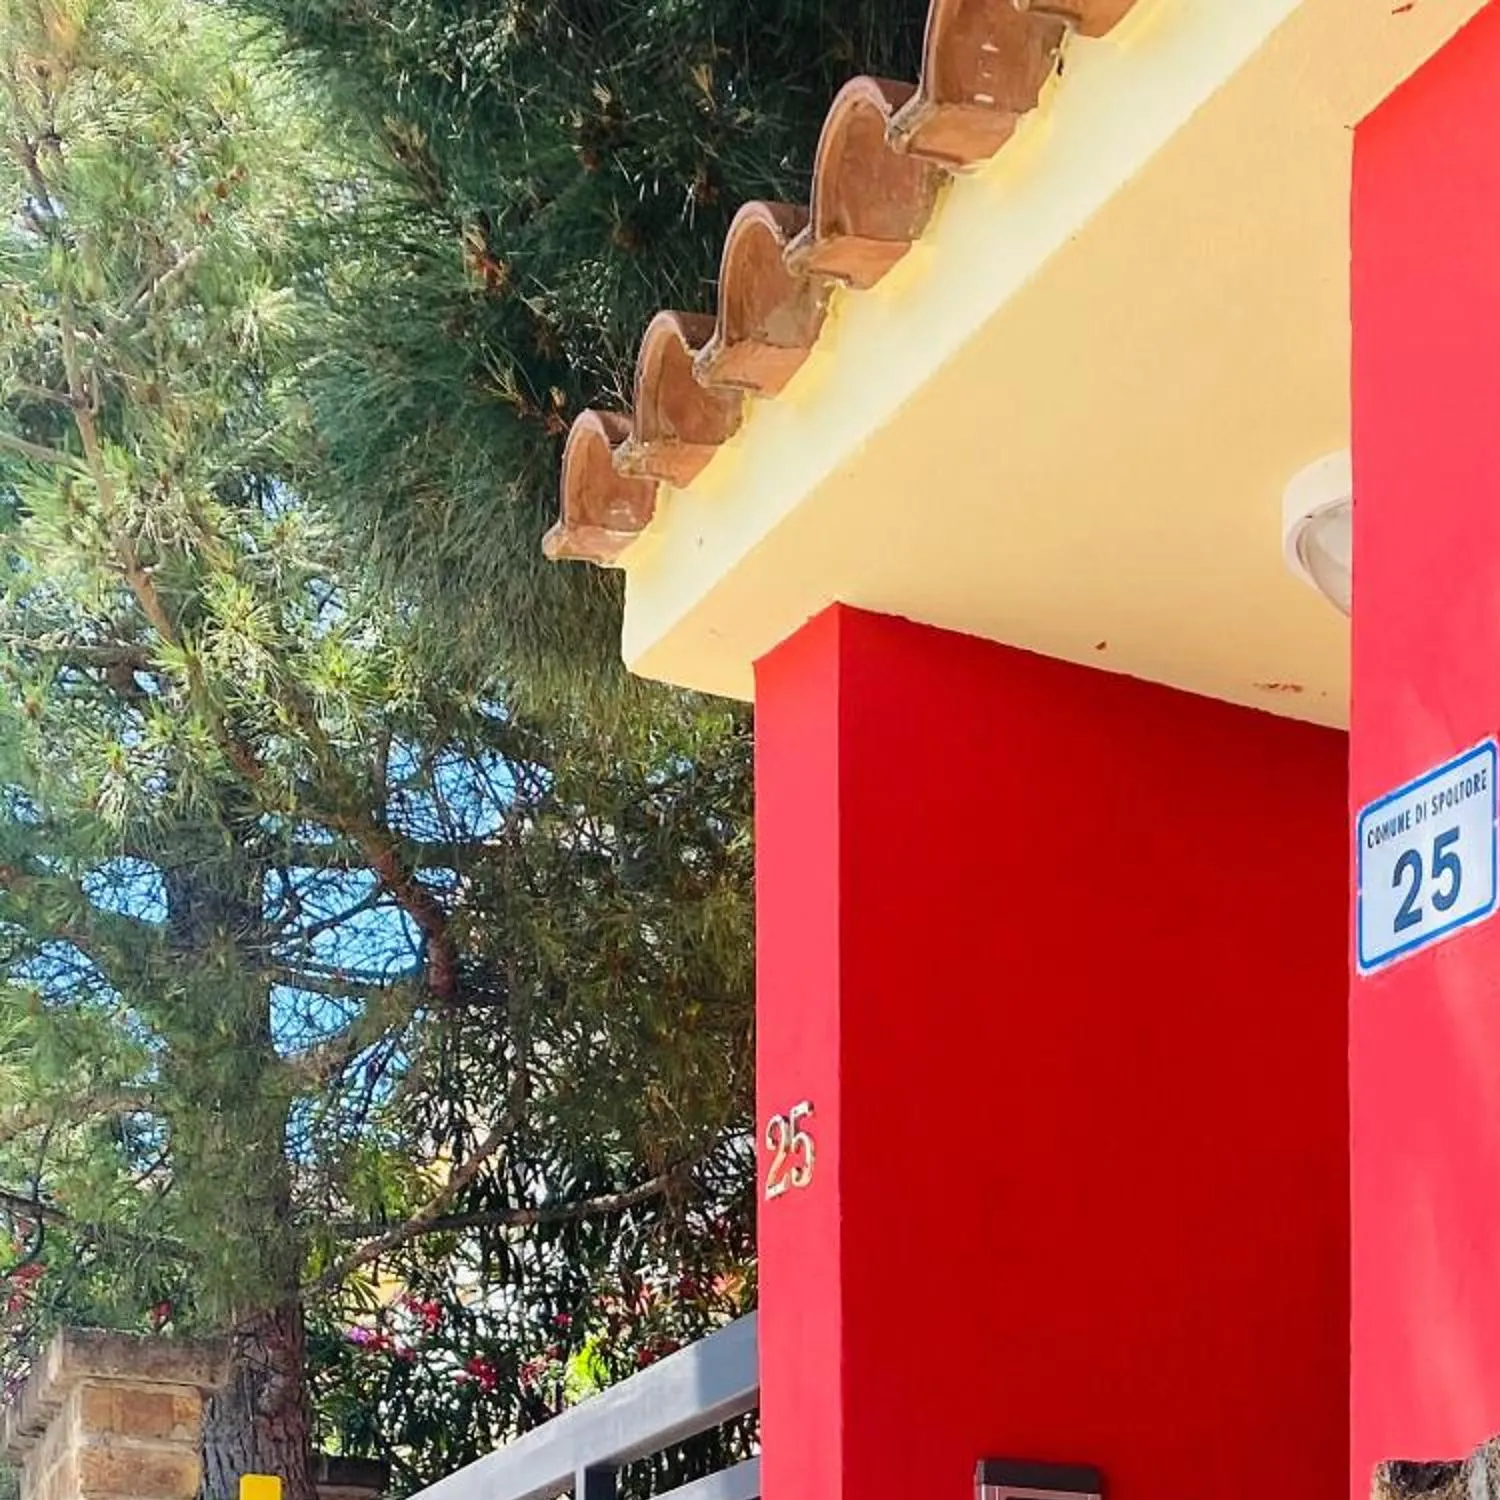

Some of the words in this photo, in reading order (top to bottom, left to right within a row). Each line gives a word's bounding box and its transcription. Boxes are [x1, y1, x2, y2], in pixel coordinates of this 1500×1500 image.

[1367, 809, 1411, 849] COMUNE
[1415, 803, 1427, 825] DI
[1431, 768, 1488, 817] SPOLTORE
[1391, 826, 1462, 933] 25
[764, 1100, 816, 1200] 25
